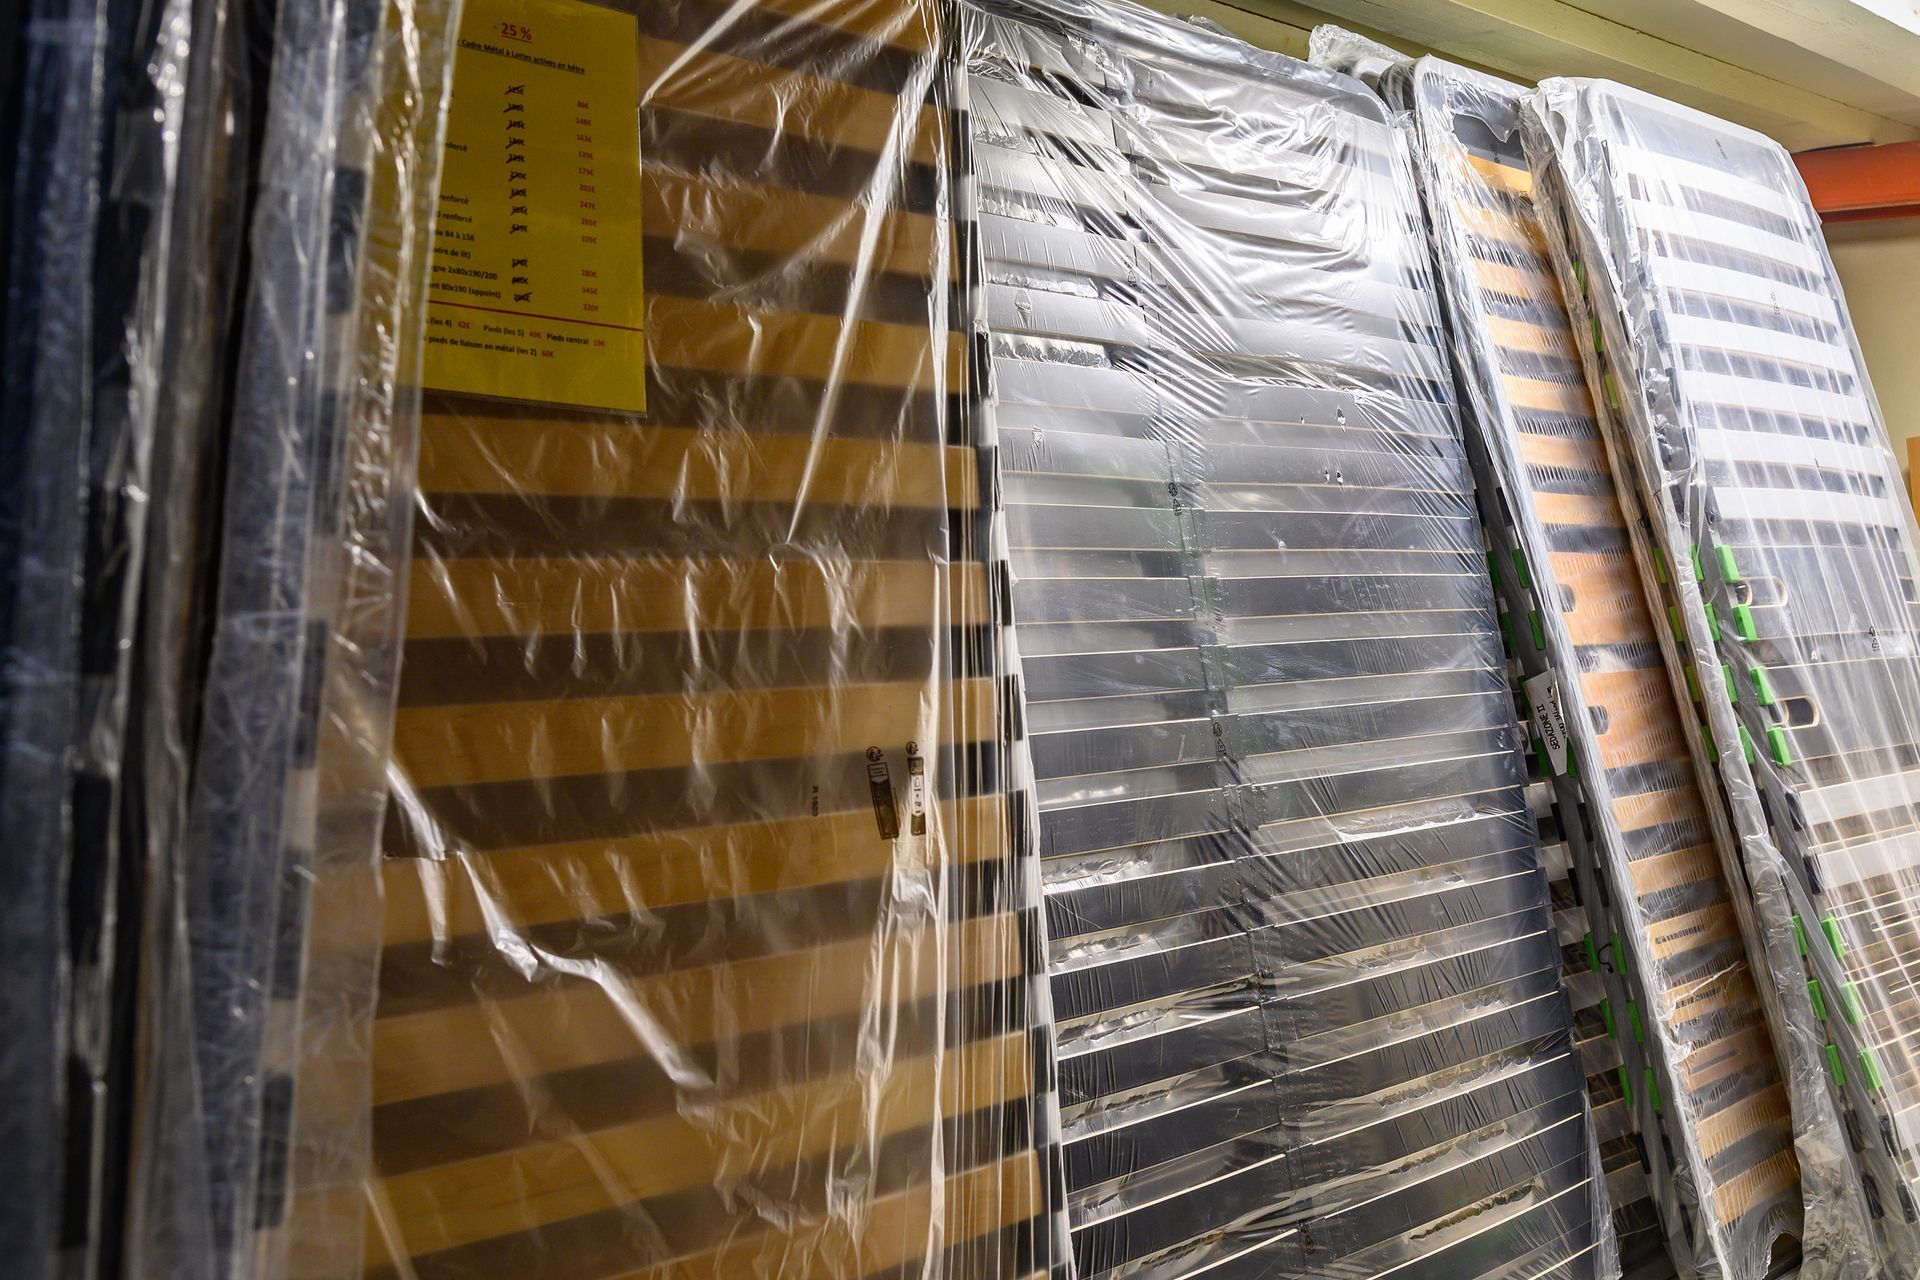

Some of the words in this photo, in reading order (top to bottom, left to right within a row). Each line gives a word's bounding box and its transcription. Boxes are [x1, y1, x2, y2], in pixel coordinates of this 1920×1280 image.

[501, 22, 517, 38] 25
[519, 26, 533, 42] %
[461, 38, 482, 50] Cadre
[483, 43, 505, 55] Métal
[512, 50, 533, 62] Lattes
[534, 56, 556, 68] actives
[442, 213, 473, 224] renforcé
[450, 248, 459, 256] de
[460, 250, 471, 260] lit)
[441, 283, 467, 293] 80x190
[467, 286, 501, 300] (appoint)
[483, 324, 502, 334] Pieds
[546, 332, 565, 342] Pieds
[565, 336, 589, 345] central
[428, 336, 448, 345] pieds
[449, 337, 460, 346] de
[460, 339, 483, 349] liaison
[495, 345, 515, 354] métal
[1538, 713, 1560, 751] SEDAZONE
